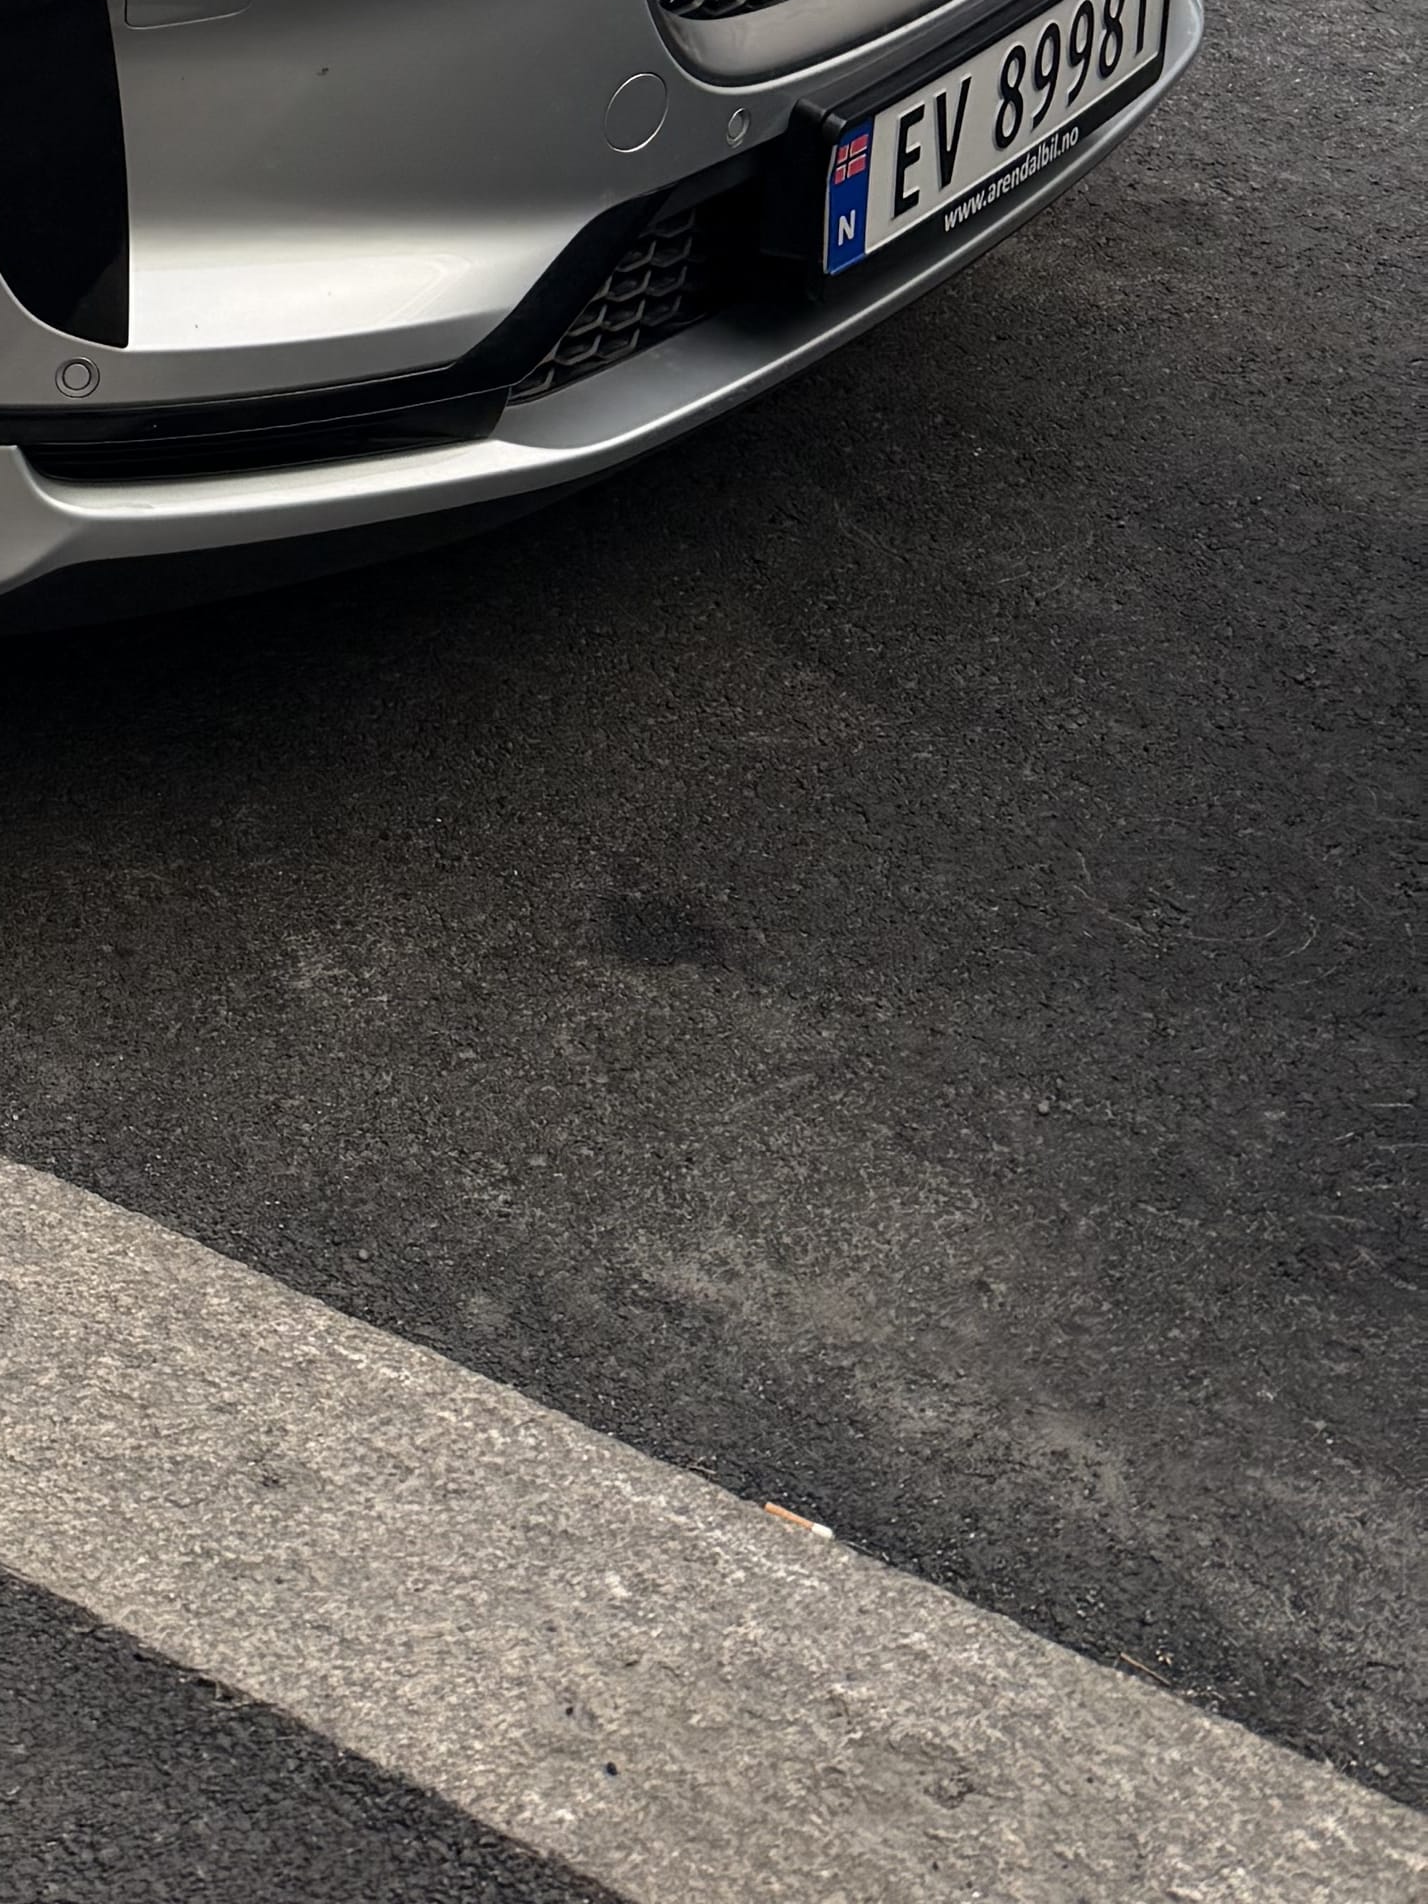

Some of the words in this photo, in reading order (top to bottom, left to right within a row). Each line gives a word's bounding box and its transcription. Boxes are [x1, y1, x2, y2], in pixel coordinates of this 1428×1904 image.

[891, 74, 973, 220] EV
[943, 125, 1079, 232] www.arendalbil.no
[837, 209, 856, 246] N
